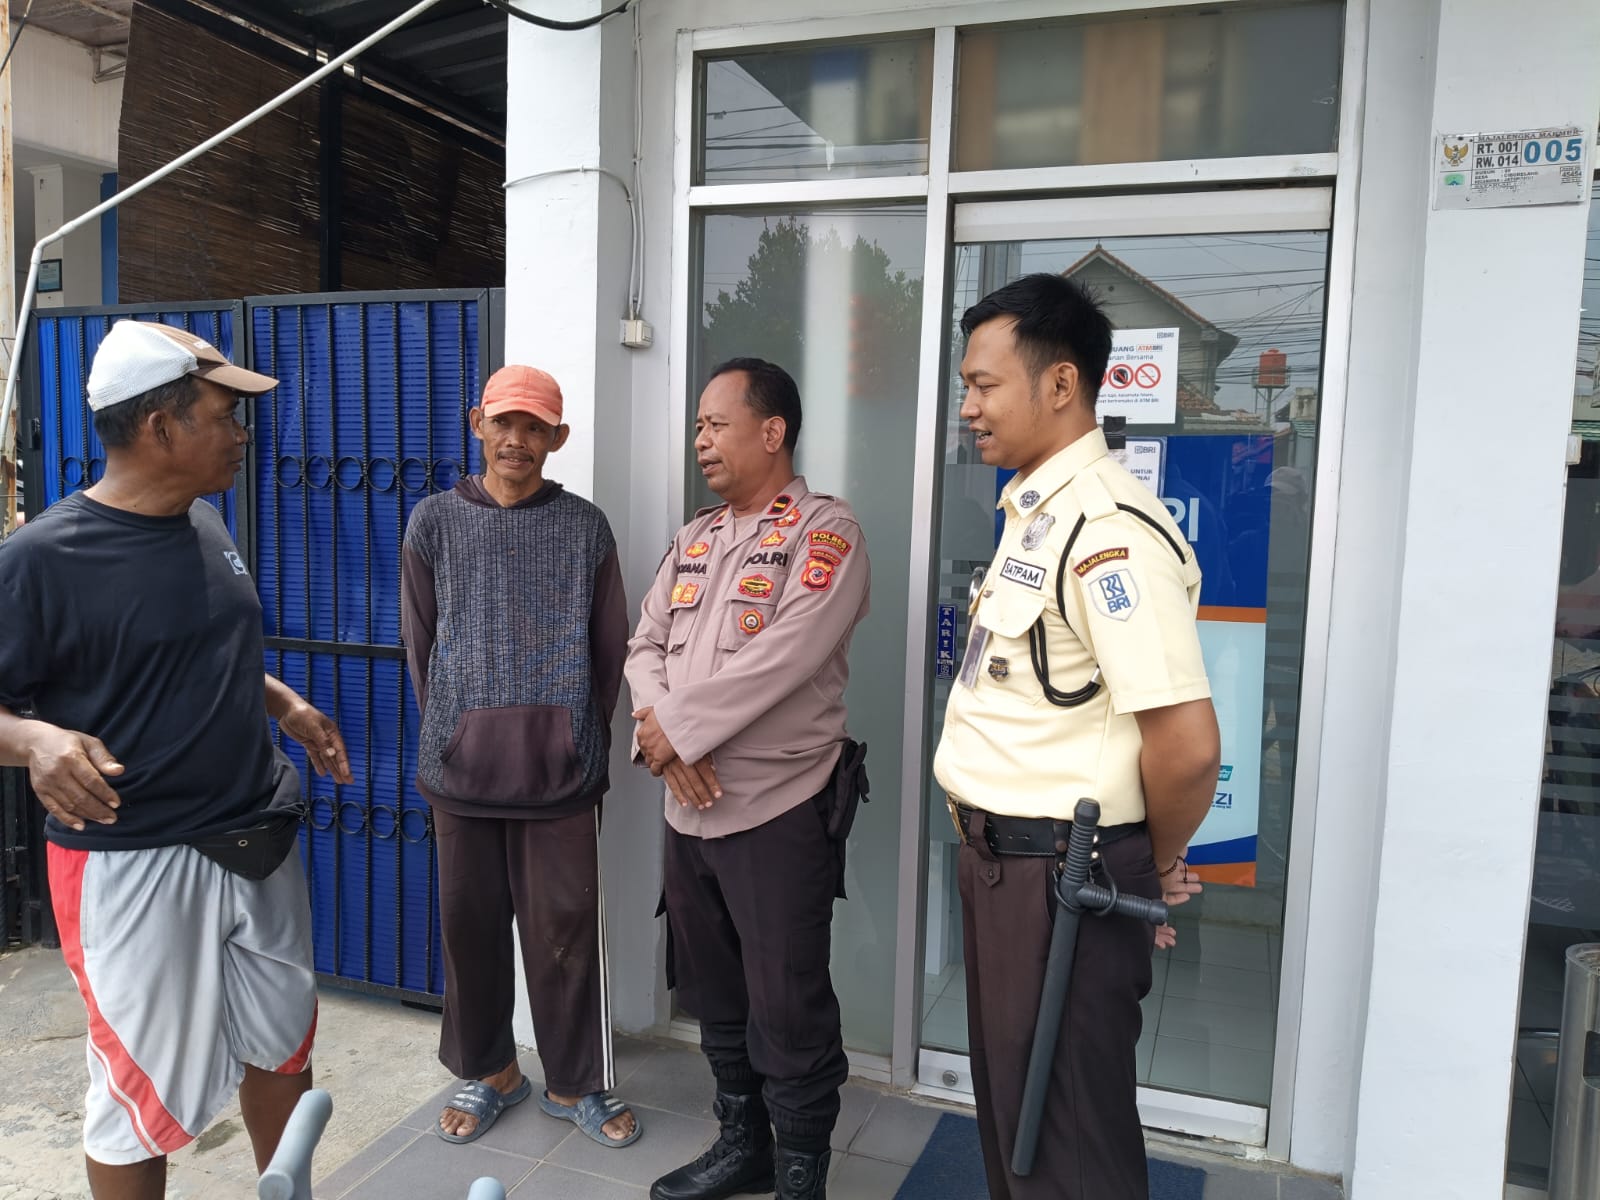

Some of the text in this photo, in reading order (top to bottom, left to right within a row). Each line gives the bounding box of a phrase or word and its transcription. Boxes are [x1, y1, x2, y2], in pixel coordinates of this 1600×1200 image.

[1477, 142, 1519, 154] RT. 001
[1524, 138, 1582, 164] 005
[1476, 155, 1519, 168] RW. 014
[1077, 549, 1126, 574] MAJALENGKA
[1004, 562, 1040, 584] SATPAM
[1106, 594, 1132, 614] BRI
[940, 607, 953, 659] TARIK
[1212, 792, 1233, 806] ZI
